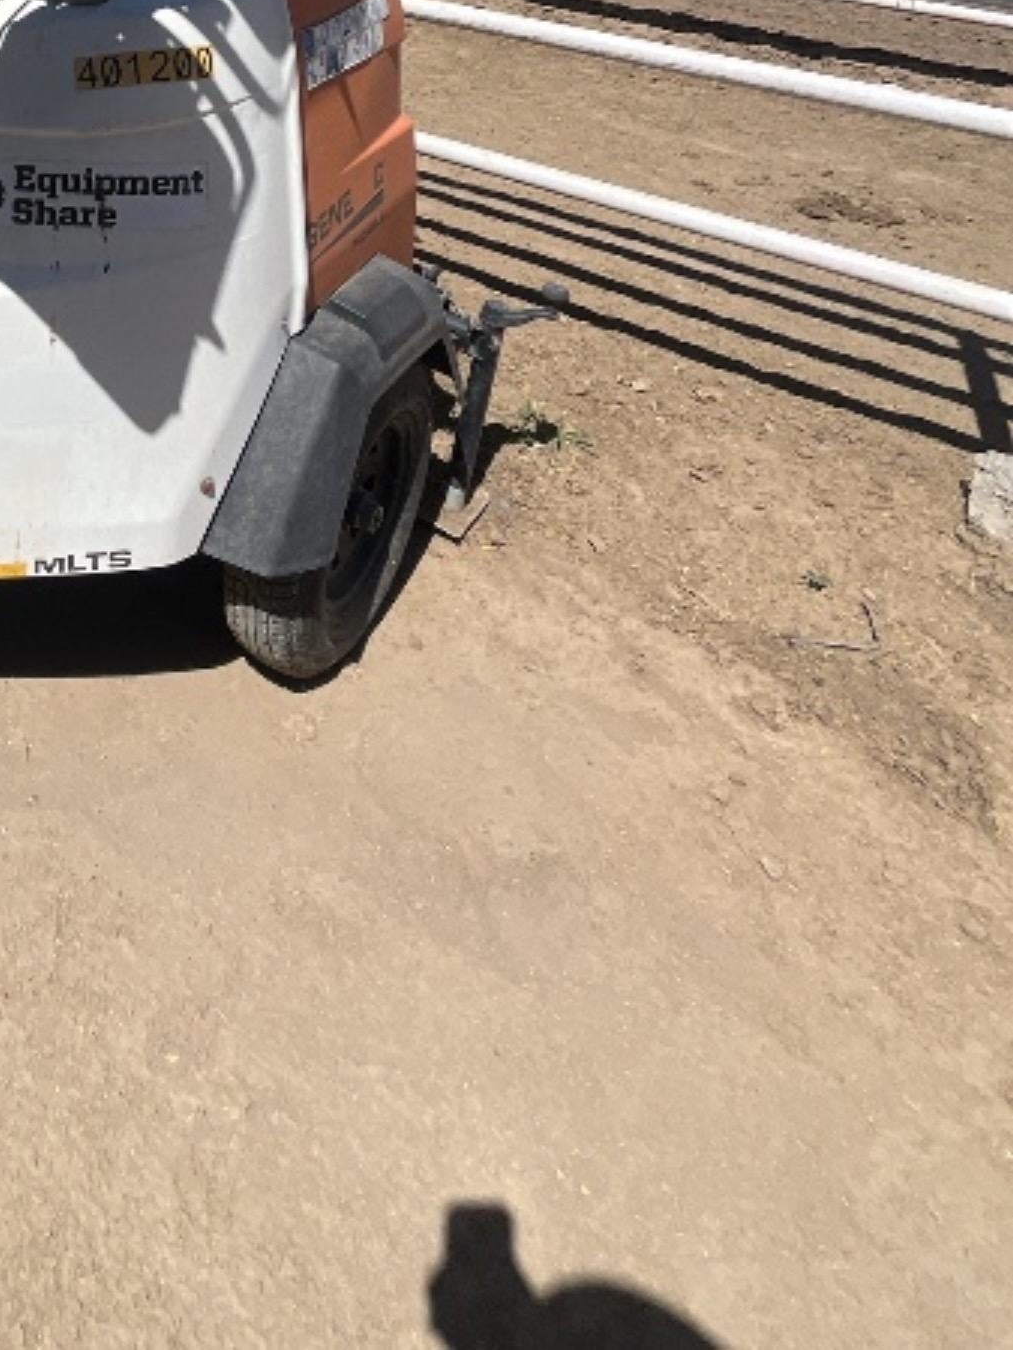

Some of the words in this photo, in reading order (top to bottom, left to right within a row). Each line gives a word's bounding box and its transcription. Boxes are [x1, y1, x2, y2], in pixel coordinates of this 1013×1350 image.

[76, 47, 213, 88] 401200
[13, 164, 204, 201] Equipment
[11, 197, 117, 228] Share
[34, 549, 132, 574] MLTS
